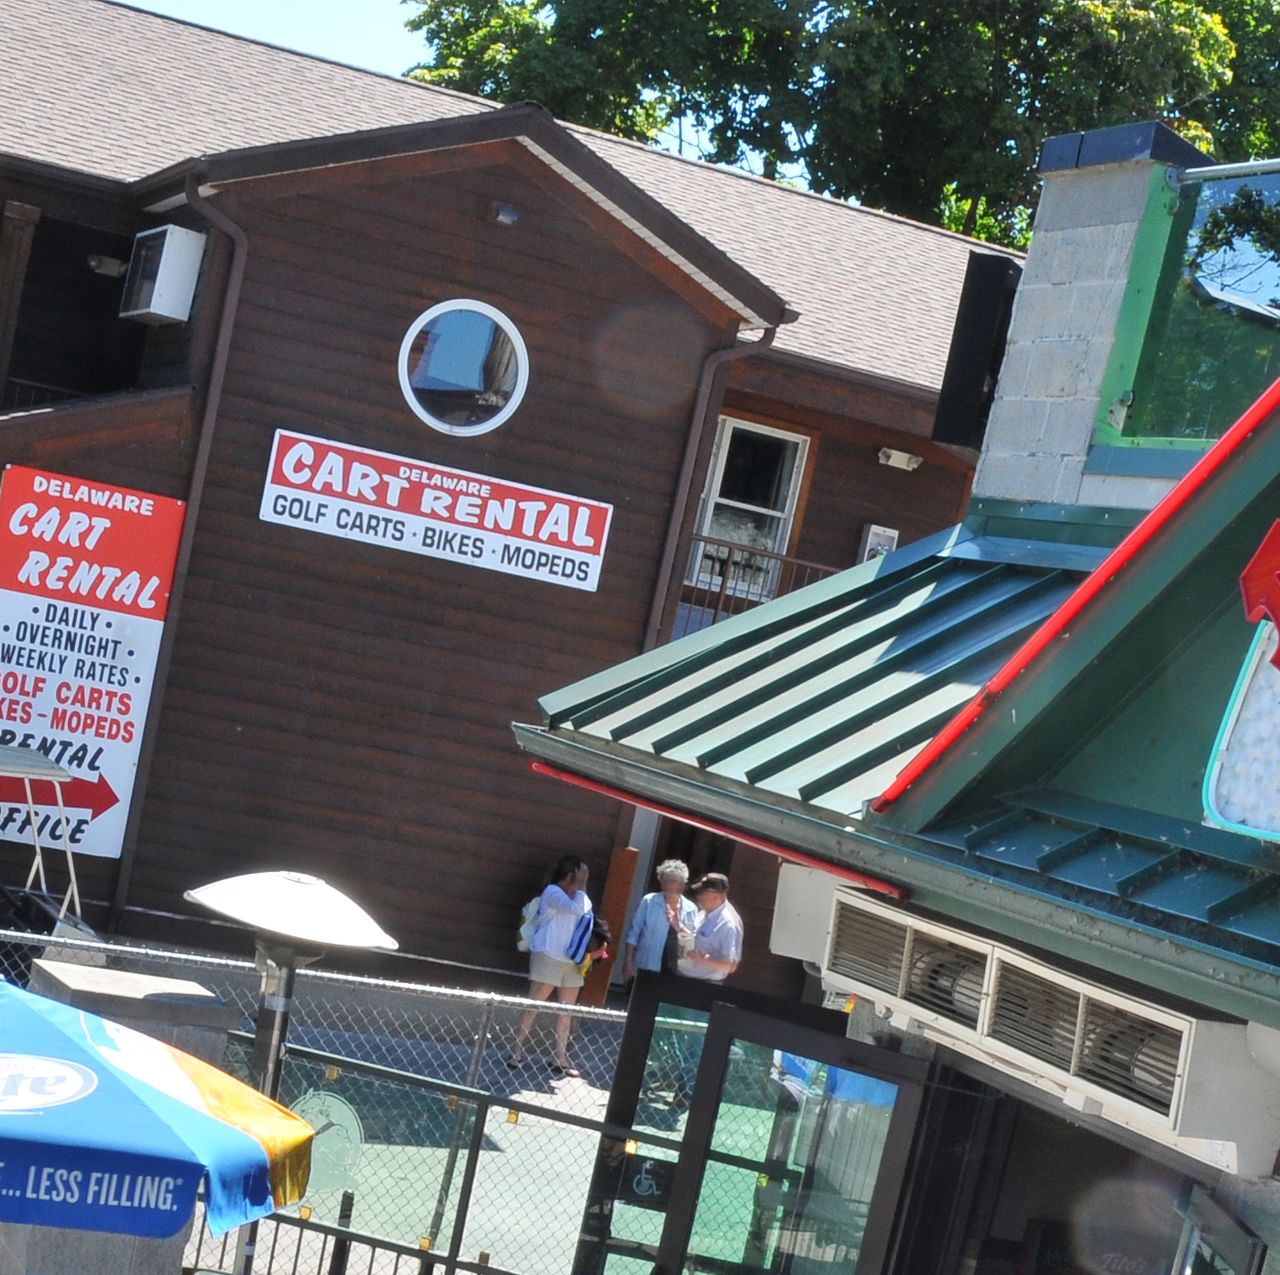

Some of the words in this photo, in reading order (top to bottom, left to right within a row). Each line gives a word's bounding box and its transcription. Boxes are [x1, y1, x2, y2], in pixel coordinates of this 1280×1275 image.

[33, 475, 154, 516] DELAWARE
[282, 442, 410, 507] CART
[420, 487, 595, 547] RENTAL
[398, 466, 492, 498] DELAWARE
[8, 502, 111, 550] CART
[272, 494, 328, 524] GOLF
[336, 508, 406, 542] CARTS
[421, 526, 485, 559] BIKES
[500, 543, 590, 582] MOPEDS
[17, 550, 160, 609] RENTAL
[45, 603, 101, 632] DAILY
[15, 621, 122, 660] OVERNIGHT
[0, 642, 68, 674] WEEKLY
[74, 658, 129, 687] RATES
[56, 681, 132, 716] CARTS
[50, 707, 135, 743] MOPEDS
[25, 1165, 82, 1203] LESS
